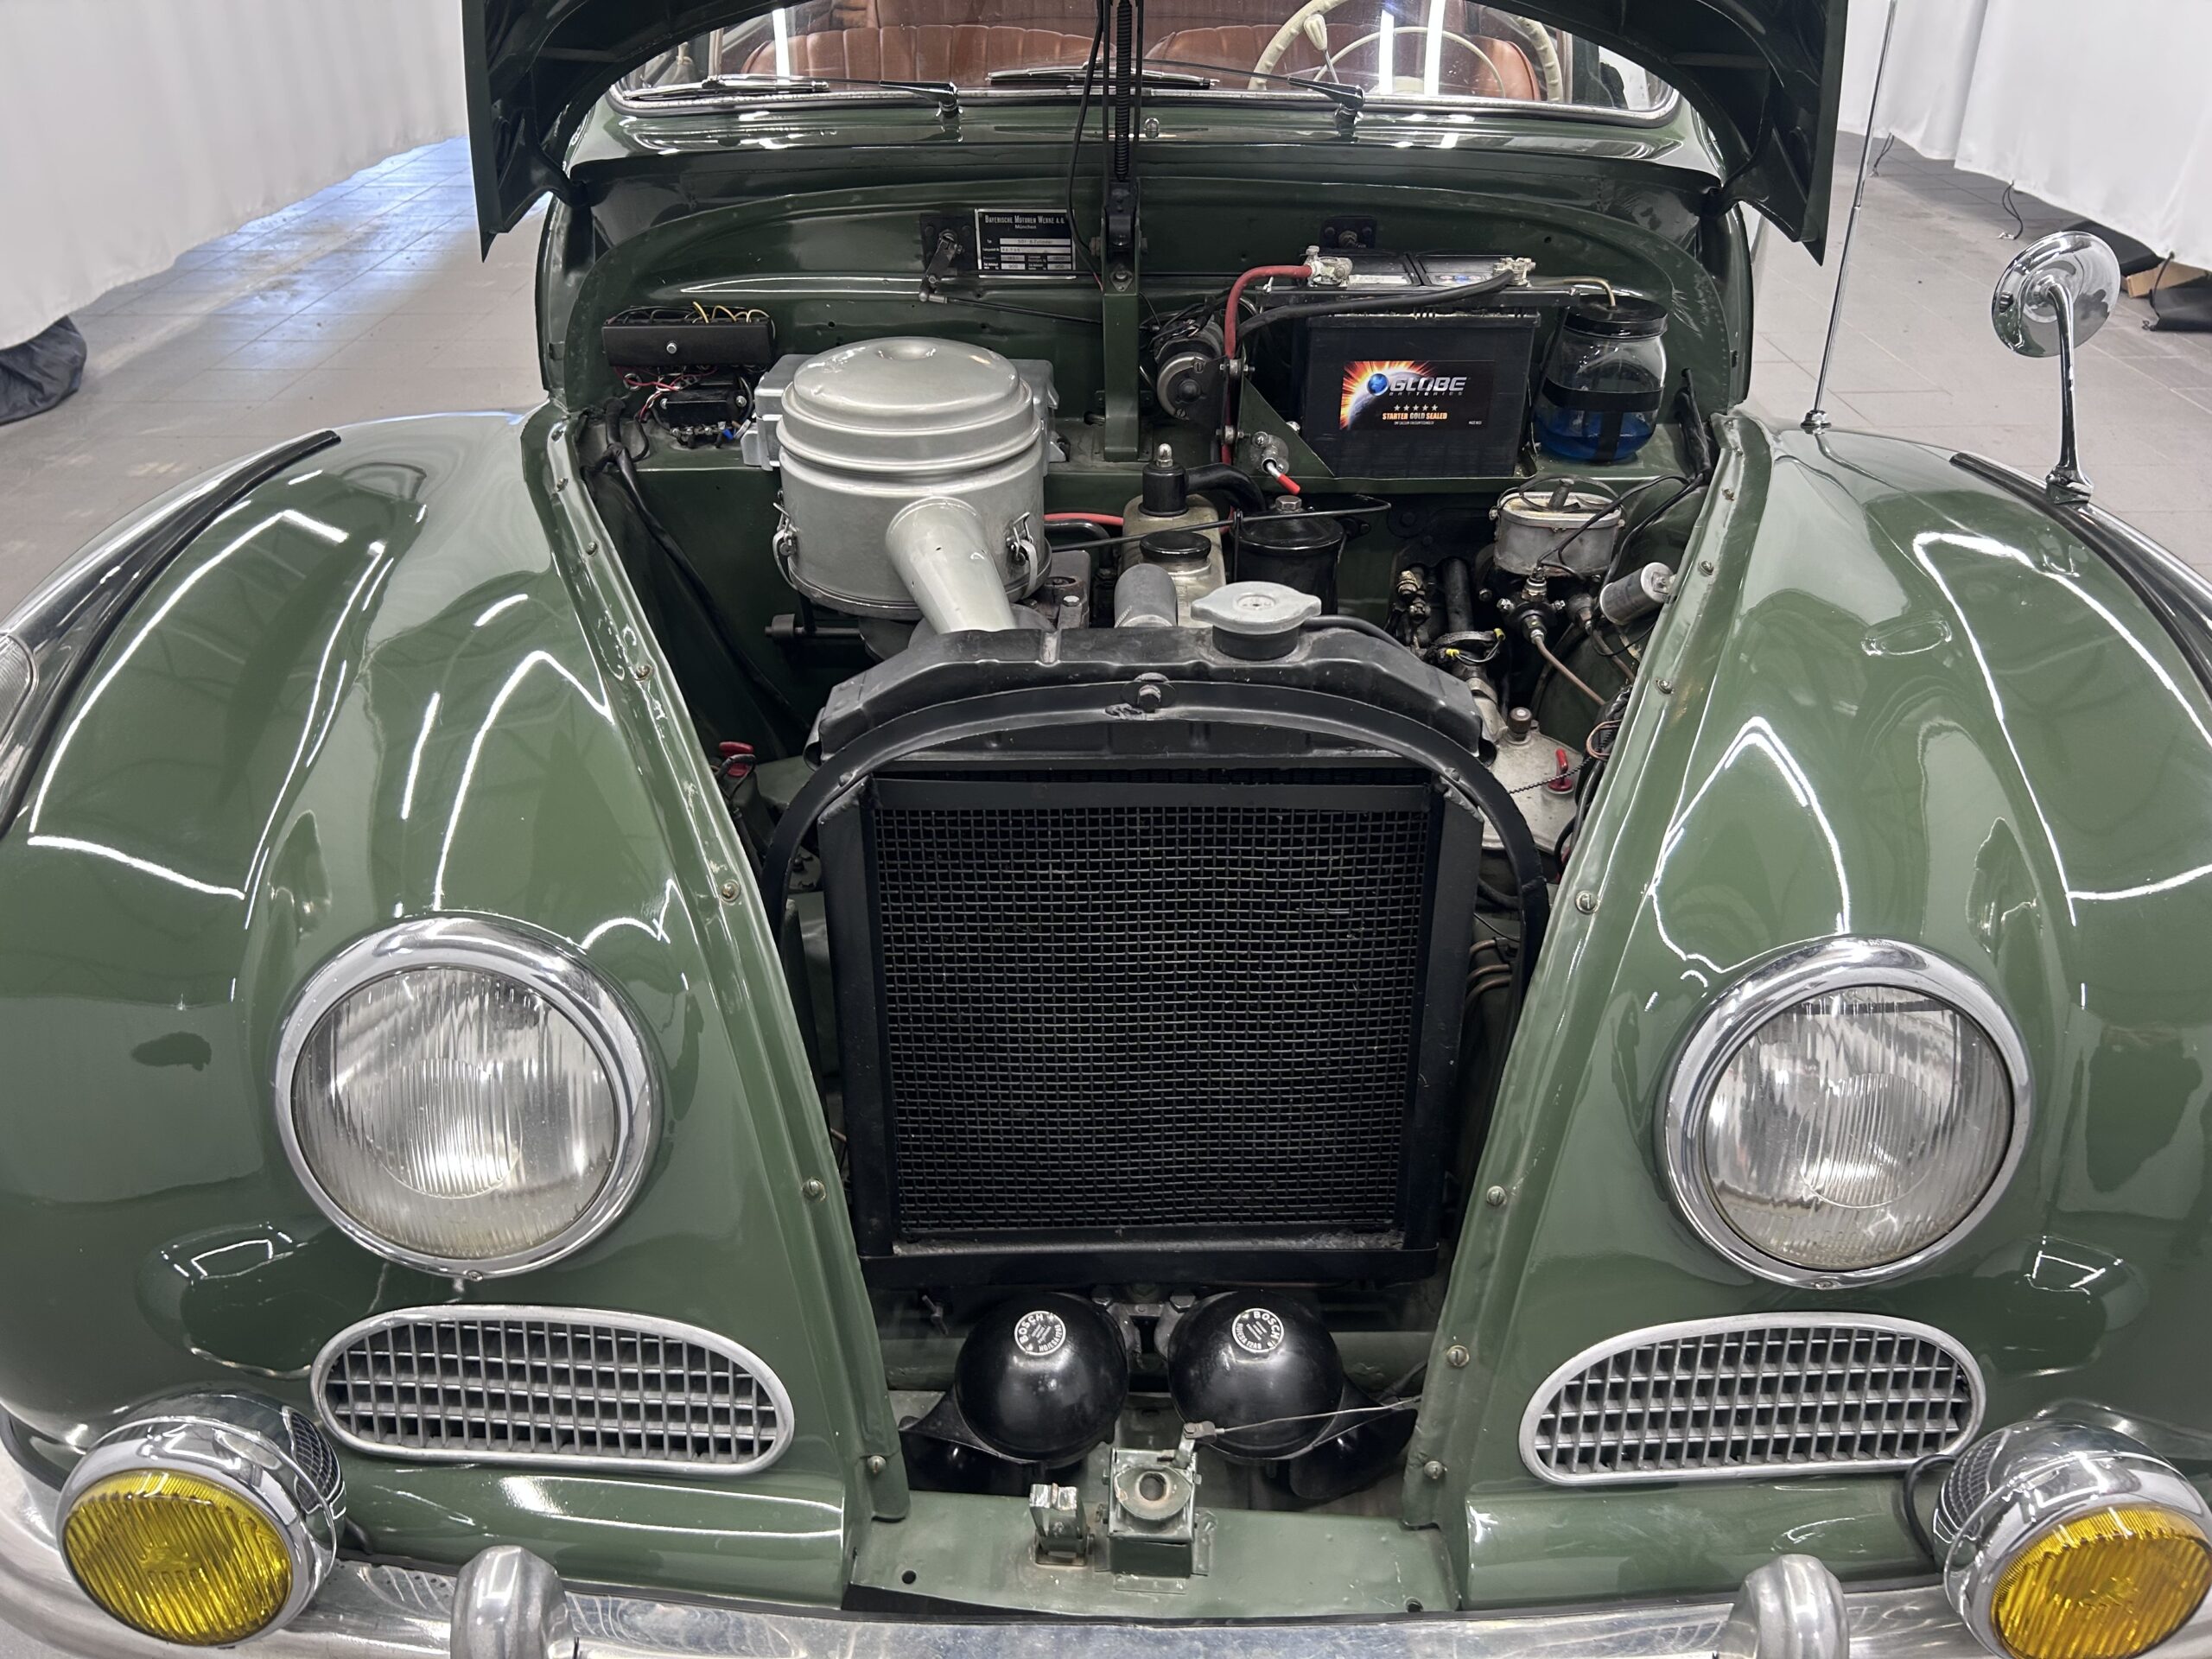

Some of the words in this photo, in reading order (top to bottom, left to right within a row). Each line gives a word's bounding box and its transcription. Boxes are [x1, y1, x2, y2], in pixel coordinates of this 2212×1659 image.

[985, 215, 1013, 224] BAYERISCHE
[1014, 215, 1037, 224] MOTOREN
[1037, 215, 1055, 224] WERKE
[1389, 377, 1467, 391] GLOBE
[1019, 1313, 1043, 1344] BOSCH
[1254, 1312, 1280, 1339] BOSCH
